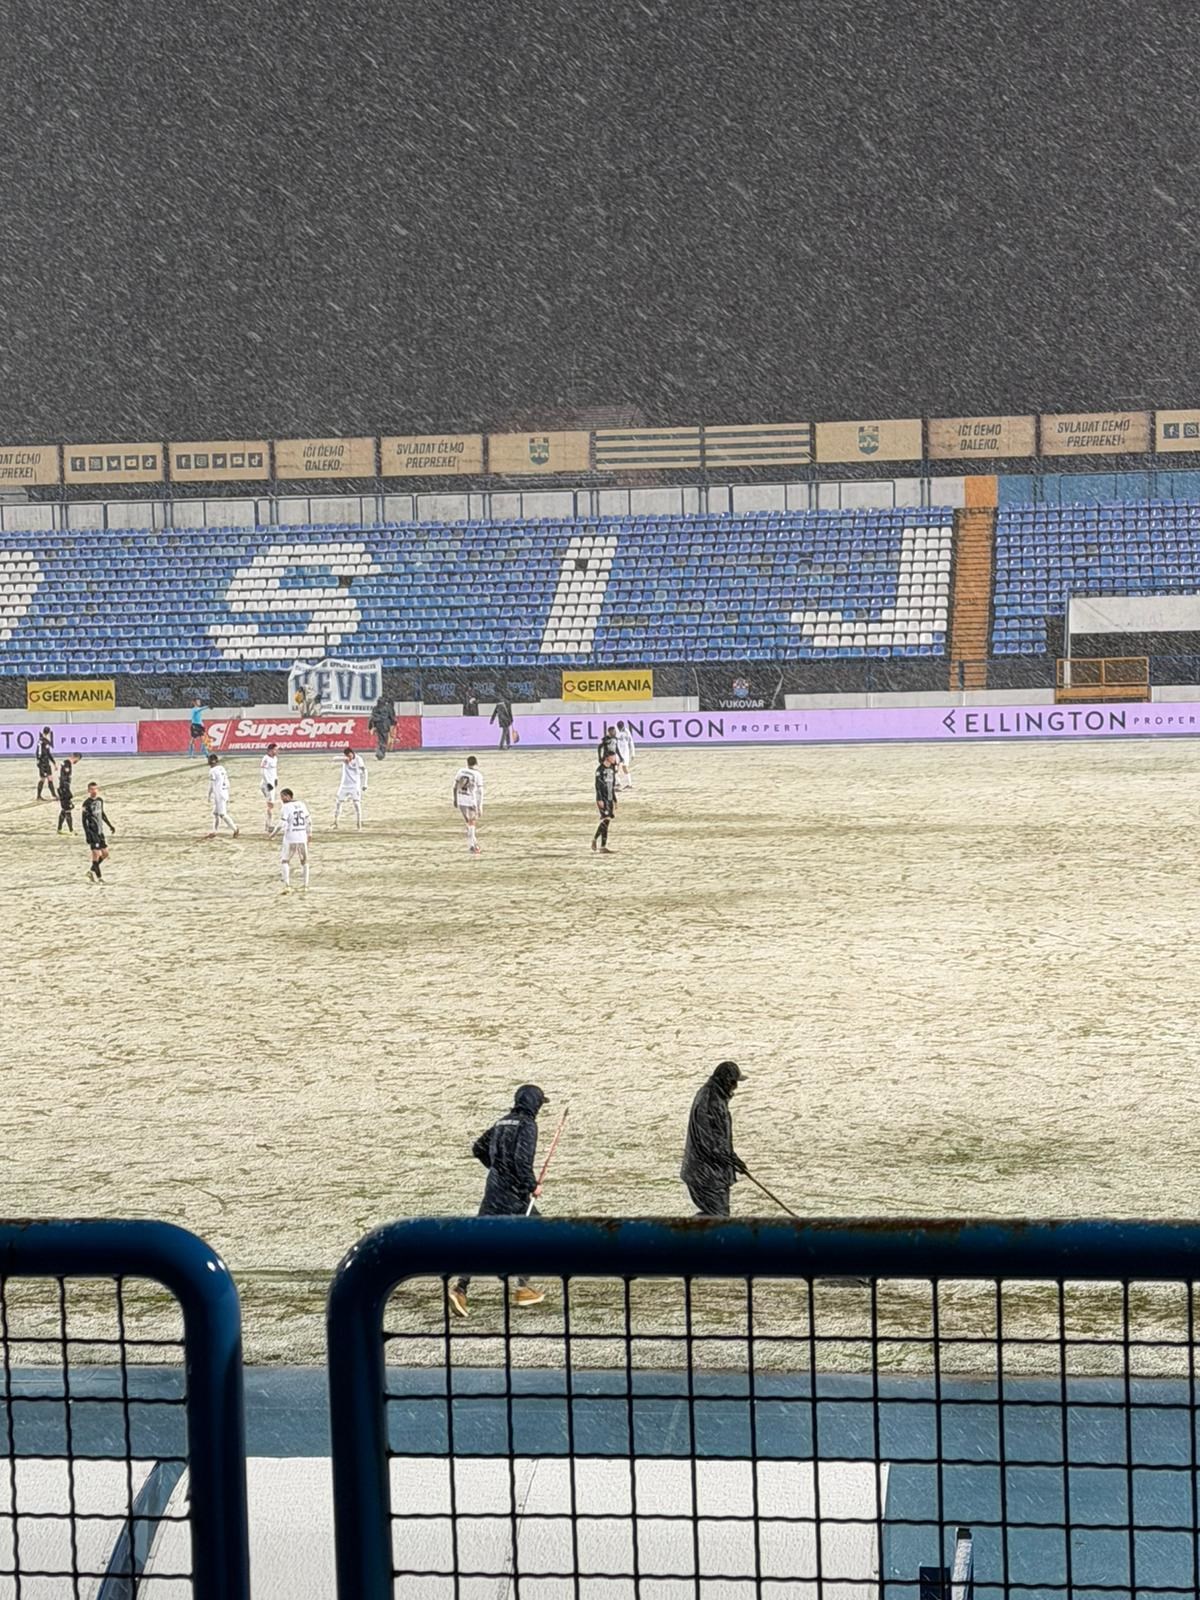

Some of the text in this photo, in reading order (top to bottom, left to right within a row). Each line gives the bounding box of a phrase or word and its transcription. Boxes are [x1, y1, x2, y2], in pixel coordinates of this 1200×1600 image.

[1057, 420, 1100, 433] SVLADAT
[396, 443, 436, 455] SVLADAT
[577, 679, 652, 693] GERMANIA
[42, 689, 114, 702] GERMANIA
[719, 699, 765, 709] VUKOVAR
[235, 719, 357, 738] SuperSport
[965, 711, 1127, 733] ELLINGTON
[570, 718, 808, 740] ELNGTON PROPERTI
[61, 736, 134, 745] PROPERTI
[329, 740, 350, 748] LIGA
[293, 810, 305, 827] 35
